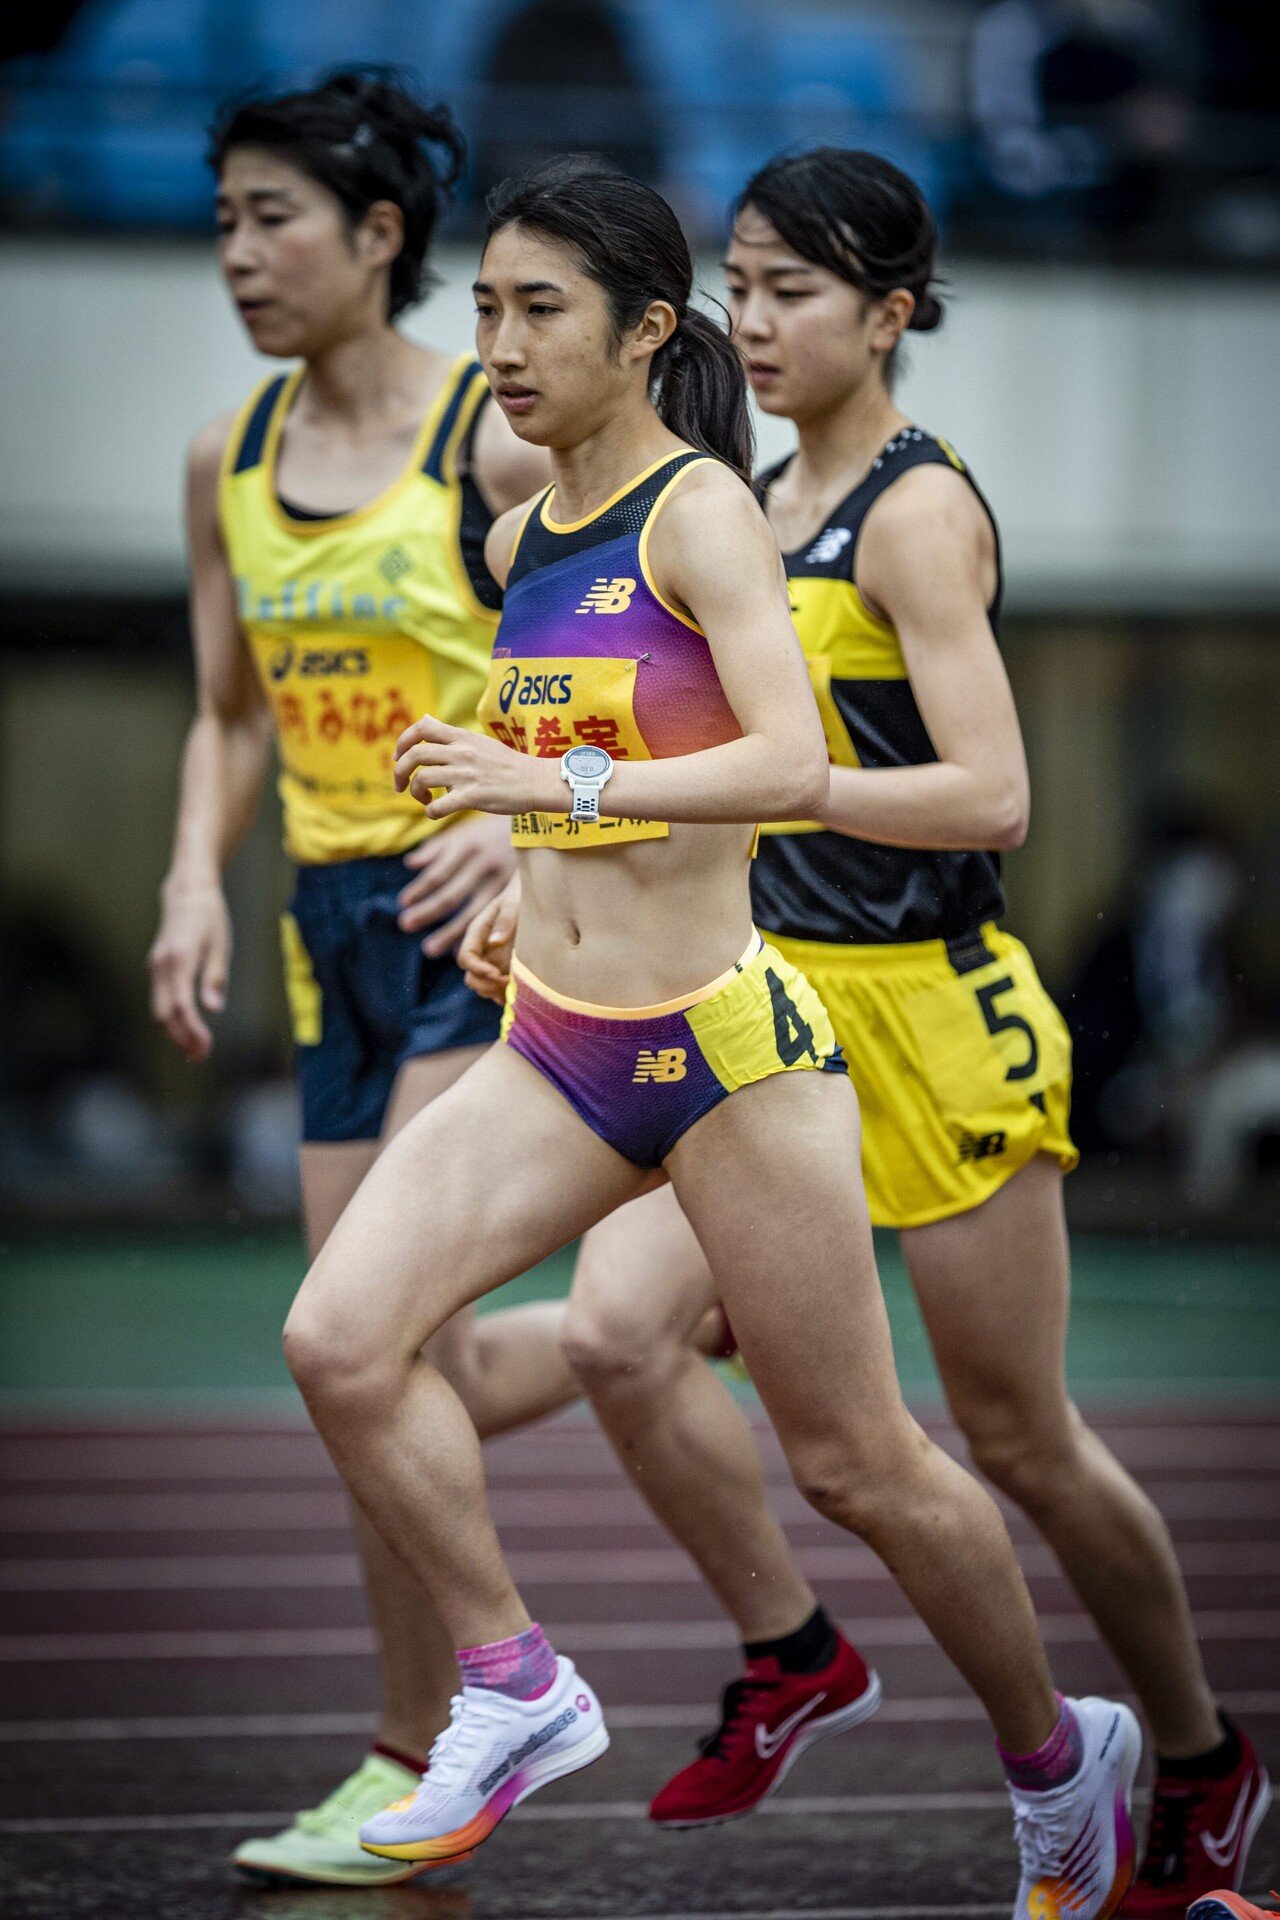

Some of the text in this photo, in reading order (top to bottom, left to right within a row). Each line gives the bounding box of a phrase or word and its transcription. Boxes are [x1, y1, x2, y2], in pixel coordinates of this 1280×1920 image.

[518, 674, 573, 706] asics
[765, 967, 819, 1067] 4
[975, 975, 1039, 1081] 5
